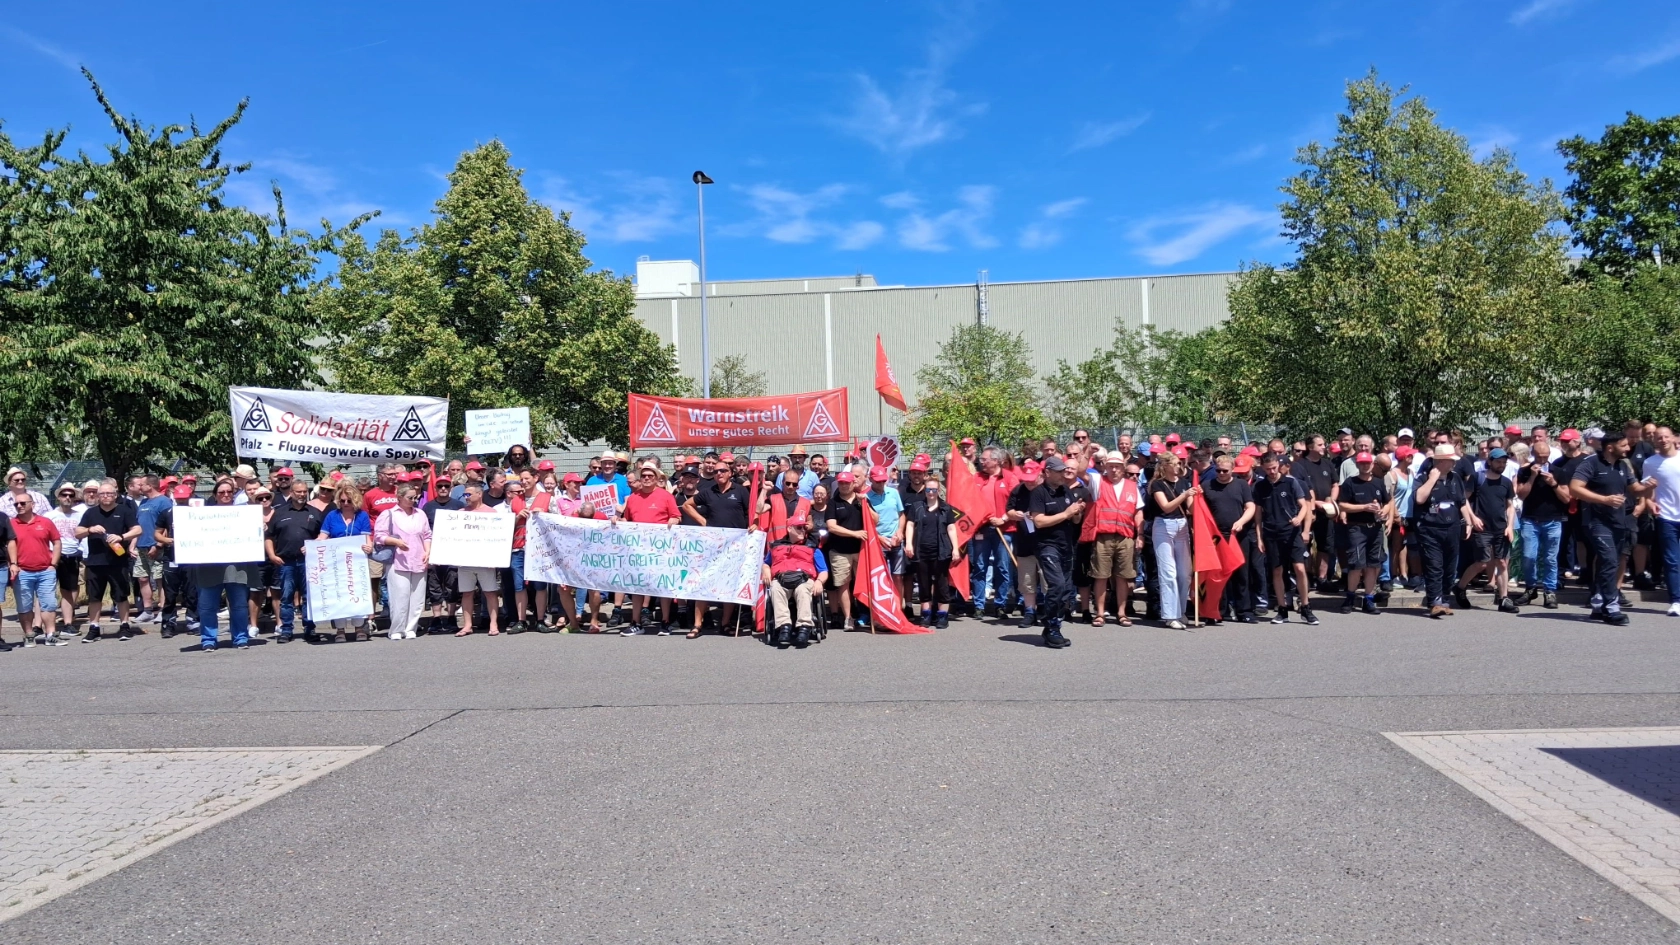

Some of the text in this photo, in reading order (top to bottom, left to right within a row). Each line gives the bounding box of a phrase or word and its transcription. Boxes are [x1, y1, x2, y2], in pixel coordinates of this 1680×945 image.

[641, 404, 674, 440] IGM
[688, 404, 789, 424] Warnstreik
[805, 400, 838, 437] IGM
[276, 411, 389, 442] Solidarität
[688, 425, 789, 439] unser gutes Recht
[240, 437, 262, 450] Pfalz
[278, 440, 380, 459] Flugzeugwerke
[385, 448, 430, 462] Speyer
[584, 489, 609, 502] HÄNDE
[594, 497, 611, 508] WEG
[583, 530, 704, 553] WER EINEN VON UNS
[316, 546, 327, 572] Druck
[580, 553, 625, 568] ANGREIFT
[629, 553, 661, 567] GREIFT
[668, 555, 689, 568] UNS
[611, 572, 646, 587] ALLE
